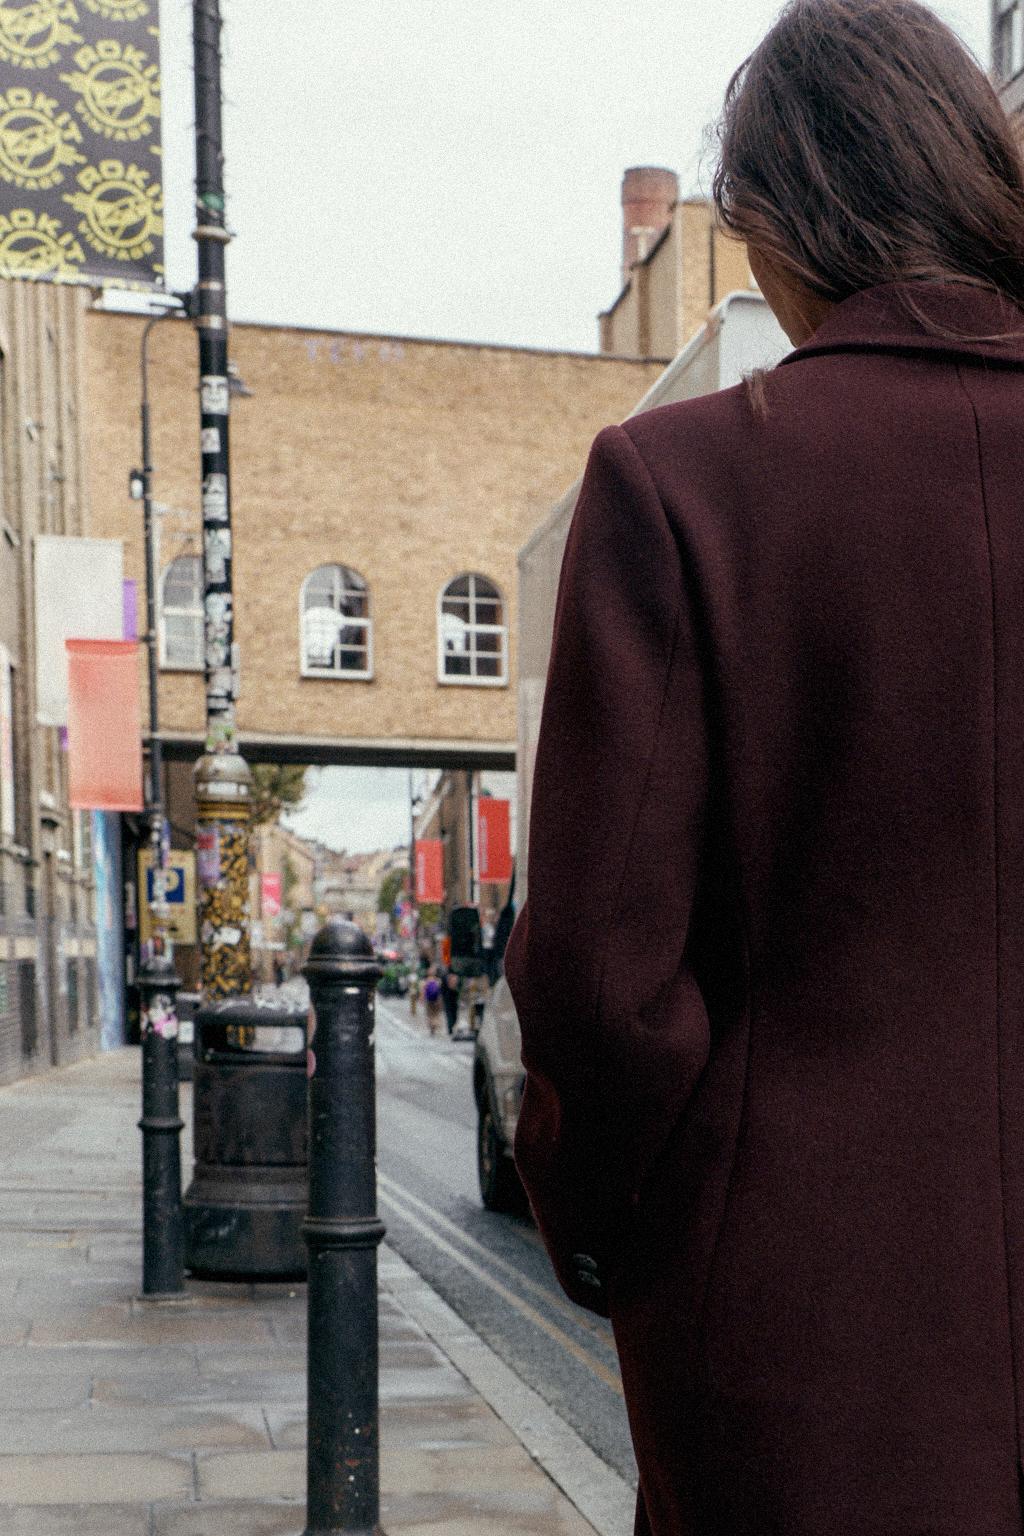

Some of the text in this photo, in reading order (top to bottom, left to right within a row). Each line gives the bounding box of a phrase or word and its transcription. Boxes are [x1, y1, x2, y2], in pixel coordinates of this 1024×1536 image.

[73, 38, 148, 71] ROK
[54, 111, 83, 143] IT
[75, 159, 150, 192] ROK
[57, 231, 86, 263] IT
[77, 220, 155, 262] VINTAGE
